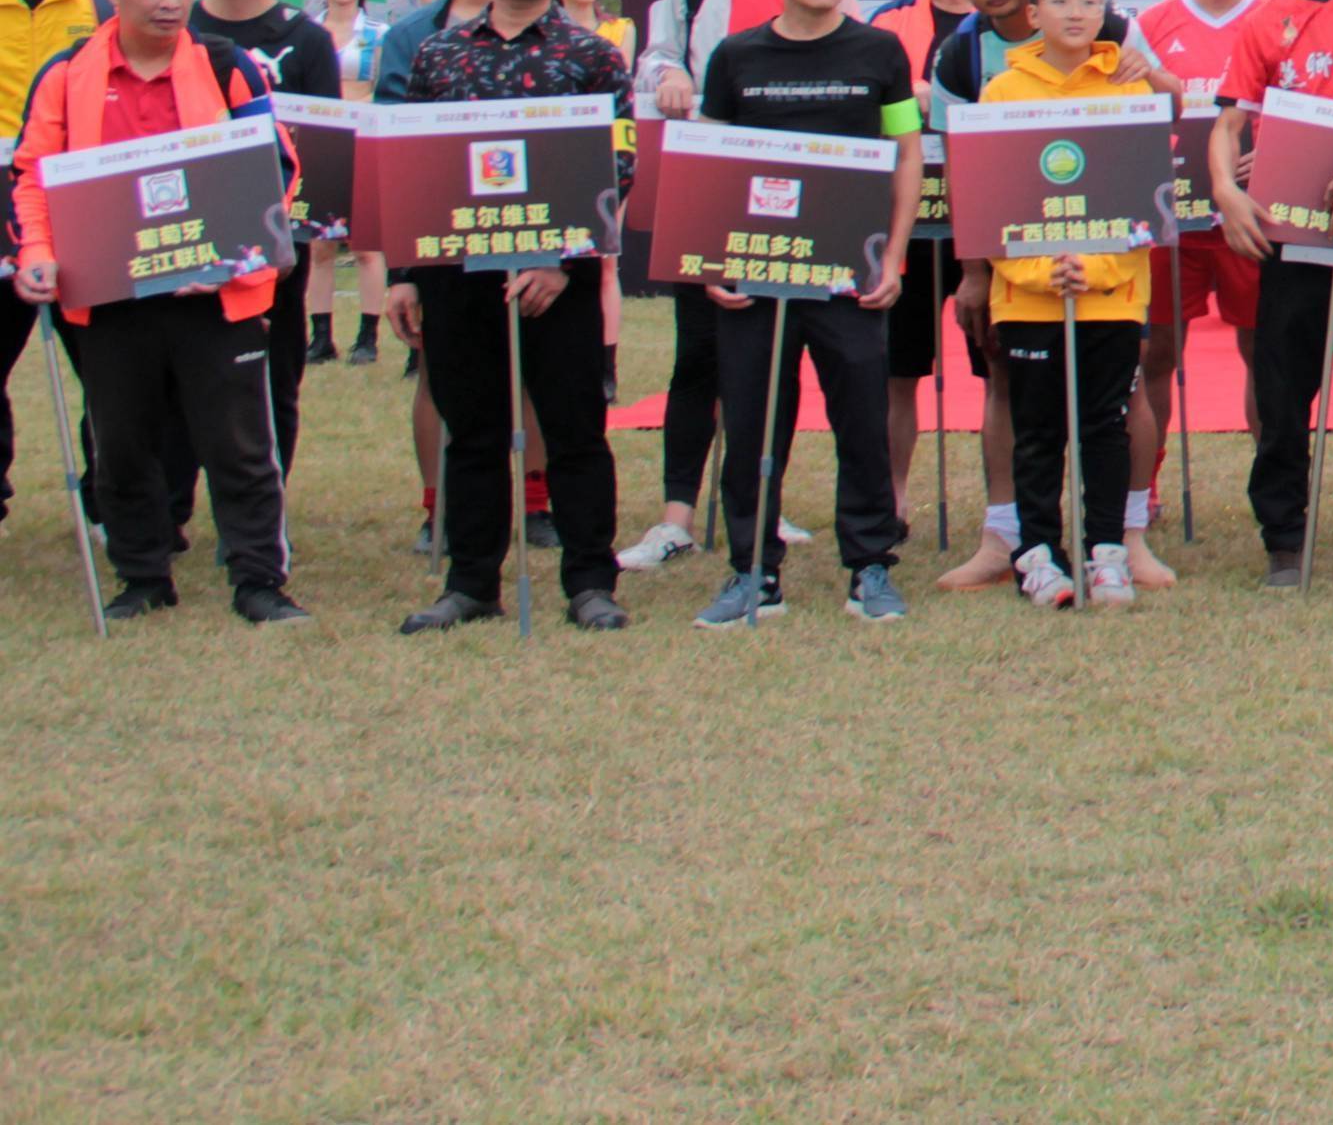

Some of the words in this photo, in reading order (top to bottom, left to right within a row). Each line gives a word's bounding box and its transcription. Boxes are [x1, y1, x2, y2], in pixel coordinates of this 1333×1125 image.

[452, 203, 550, 230] 塞尔维亚
[1042, 195, 1087, 219] 德国
[135, 219, 205, 252] 葡萄牙
[725, 231, 814, 259] 厄瓜多尔
[129, 242, 221, 279] 左江联队
